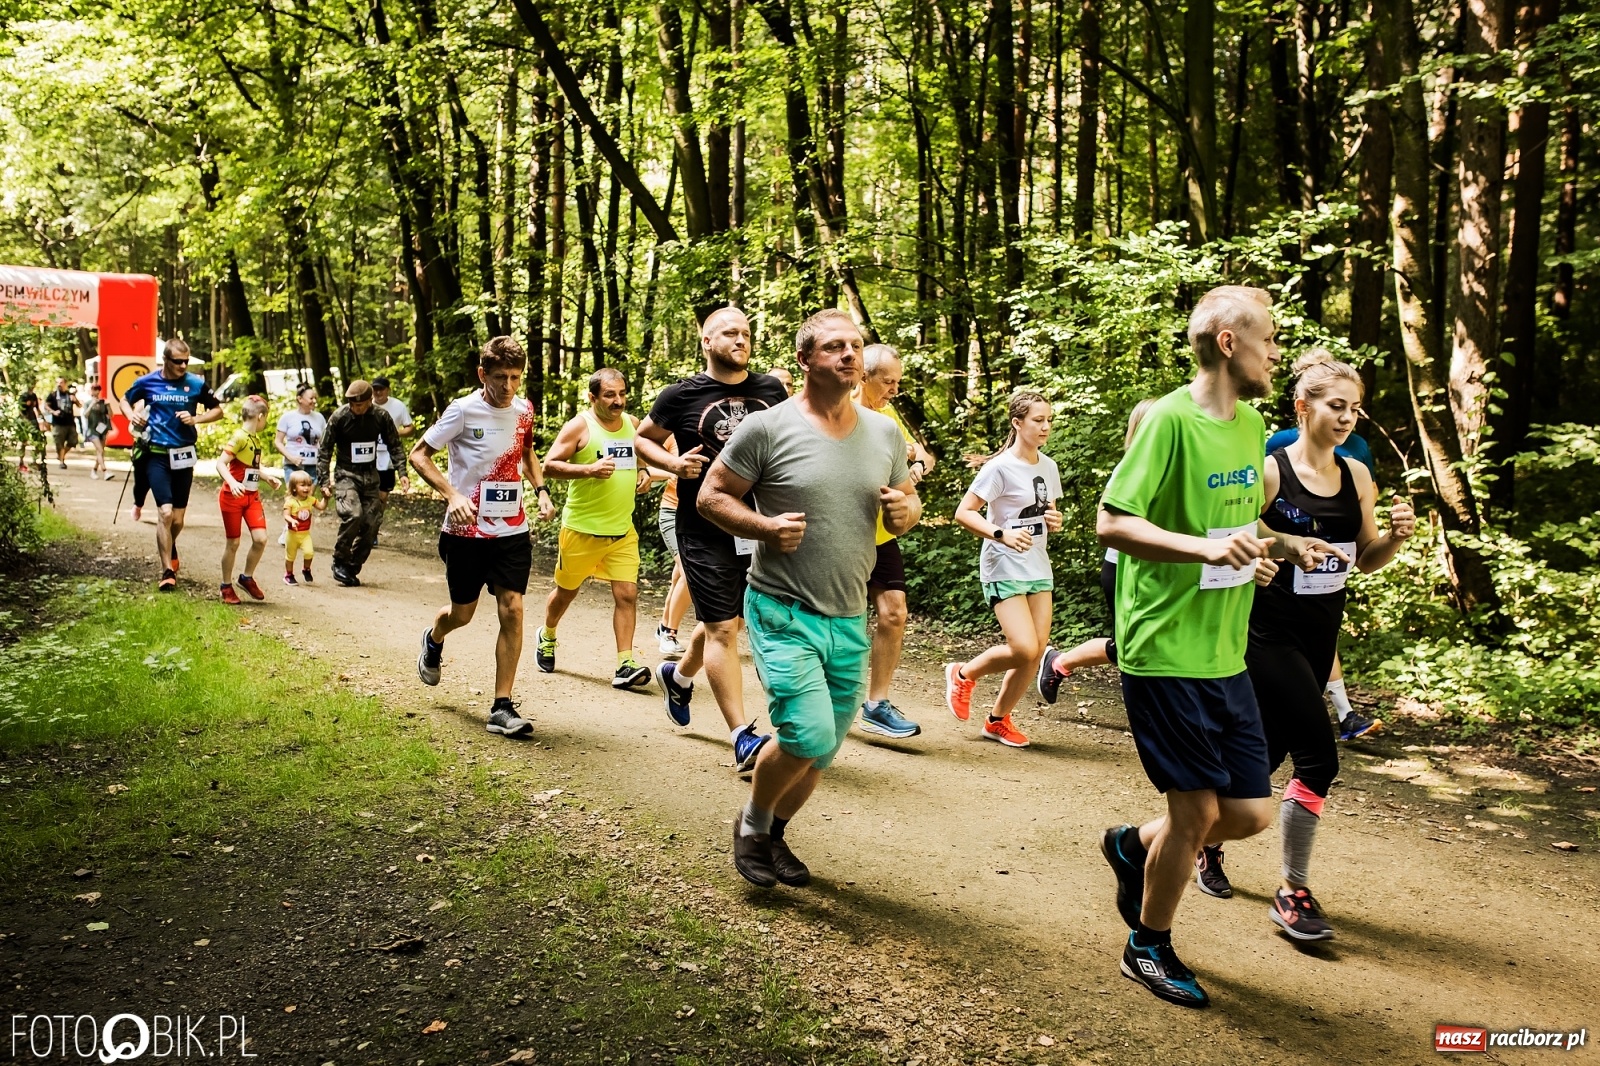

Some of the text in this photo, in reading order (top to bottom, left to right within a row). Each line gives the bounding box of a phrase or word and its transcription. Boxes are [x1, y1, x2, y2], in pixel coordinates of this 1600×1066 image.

[152, 394, 189, 403] RUNNERS
[616, 447, 628, 457] 72
[495, 490, 510, 501] 31
[1020, 524, 1035, 535] 9
[1316, 556, 1340, 572] 46
